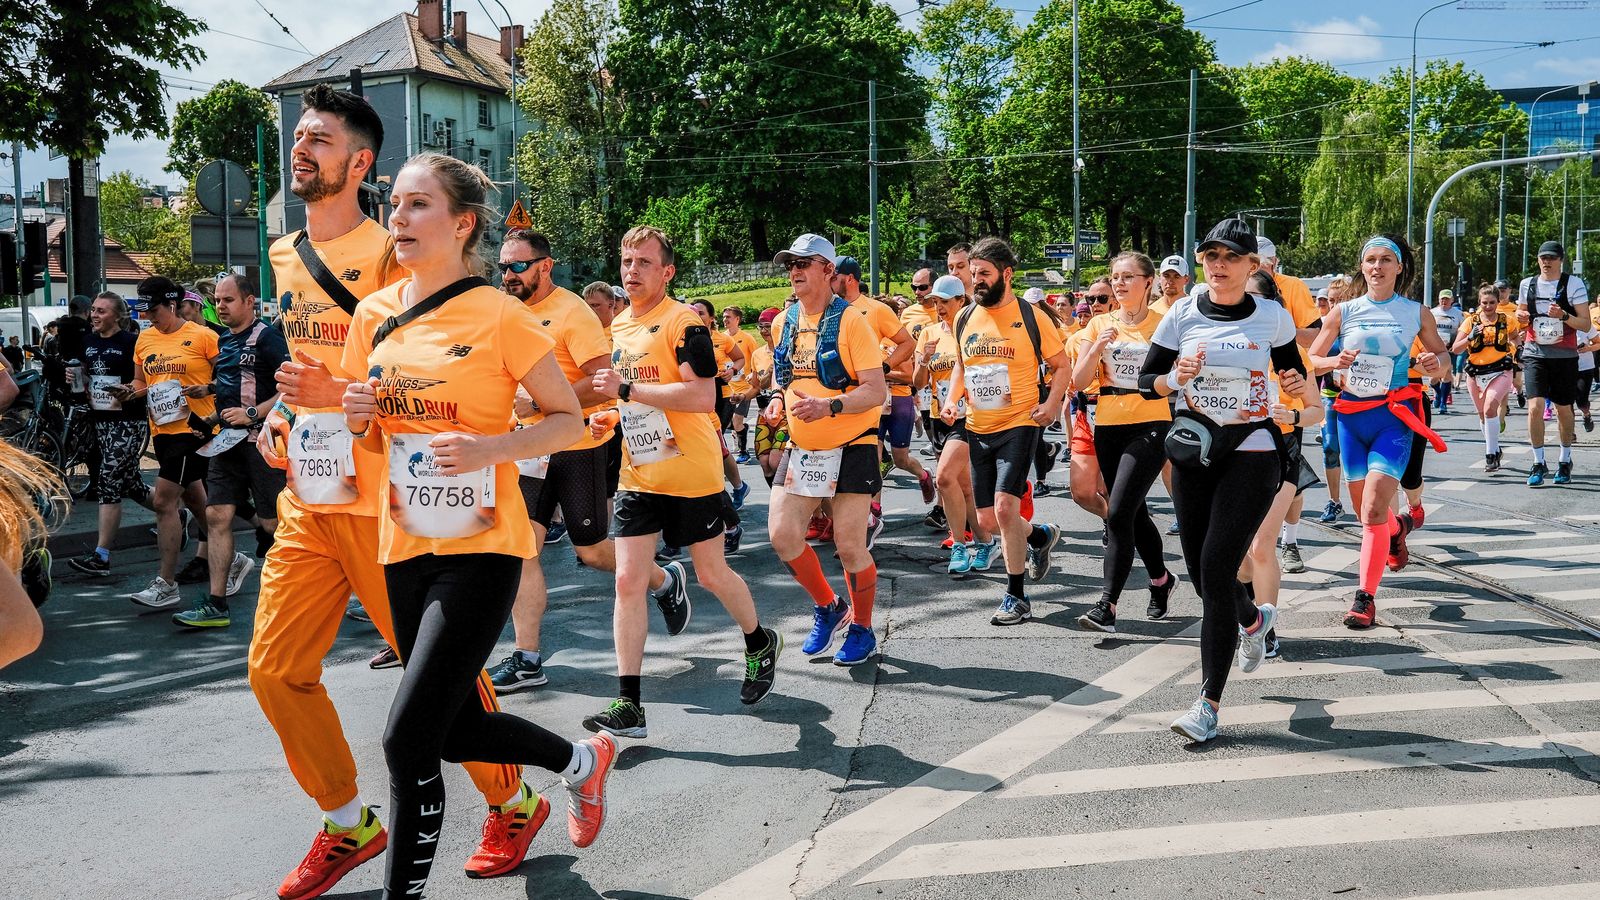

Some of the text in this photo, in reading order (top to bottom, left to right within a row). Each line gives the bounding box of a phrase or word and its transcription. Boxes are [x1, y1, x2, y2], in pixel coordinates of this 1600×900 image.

[1221, 342, 1245, 350] ING
[382, 379, 419, 389] WINGS
[1350, 376, 1378, 388] 9796
[972, 386, 1002, 397] 19266
[1192, 395, 1249, 410] 23862 4
[627, 430, 662, 448] 11004
[299, 458, 339, 477] 79631
[800, 470, 827, 482] 7596
[406, 486, 475, 507] 76758
[406, 802, 443, 894] NIKE
